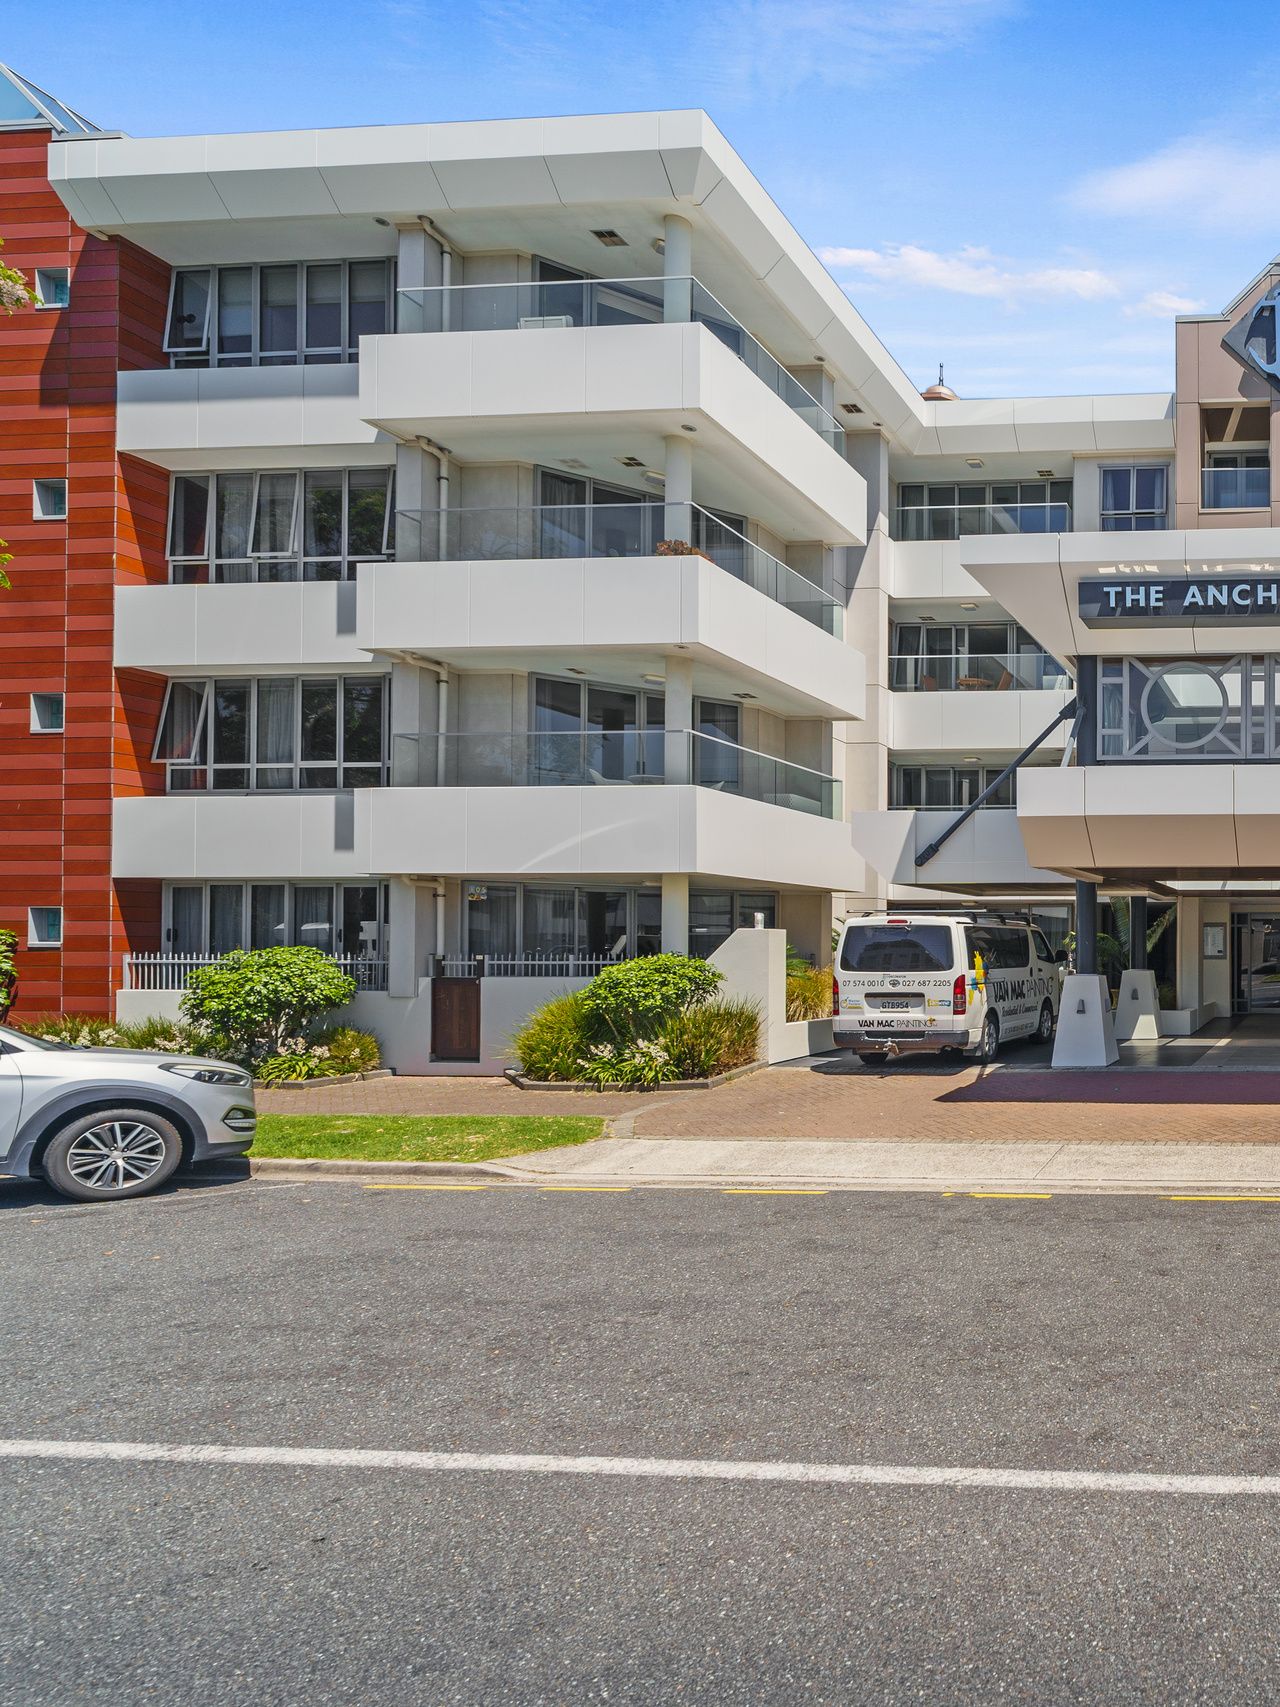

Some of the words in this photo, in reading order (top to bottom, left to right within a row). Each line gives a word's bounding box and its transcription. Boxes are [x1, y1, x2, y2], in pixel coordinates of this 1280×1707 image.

[1103, 585, 1164, 608] THE
[992, 981, 1009, 1003] VAN
[1011, 980, 1025, 1000] MAC
[857, 1019, 875, 1028] VAN
[876, 1019, 895, 1028] MAC
[896, 1019, 933, 1028] PAINTING
